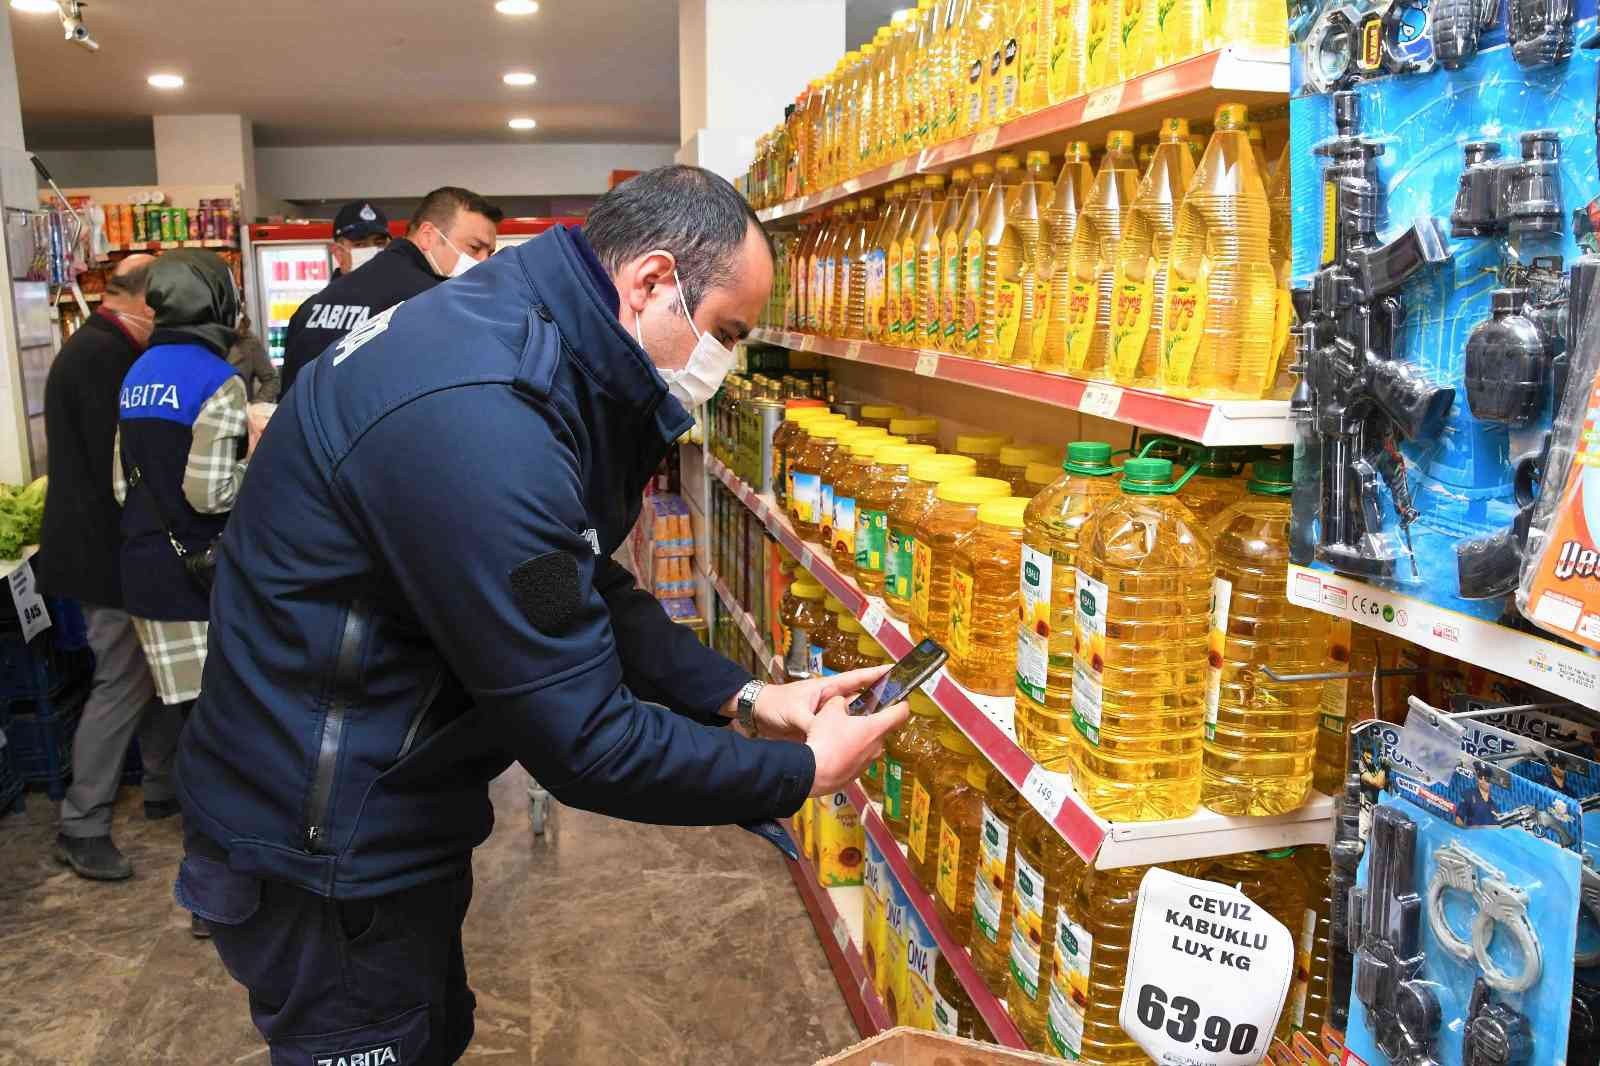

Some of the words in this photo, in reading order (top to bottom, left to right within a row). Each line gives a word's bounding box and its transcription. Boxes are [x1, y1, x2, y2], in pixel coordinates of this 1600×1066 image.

[306, 303, 371, 330] ZABITA
[121, 383, 180, 410] ABITA
[1188, 894, 1252, 922] CEVIZ
[1165, 909, 1269, 951] KABUKLU
[907, 939, 930, 982] ONA
[1172, 935, 1215, 962] LUX
[1220, 950, 1252, 972] KG
[1137, 983, 1259, 1055] 63,90
